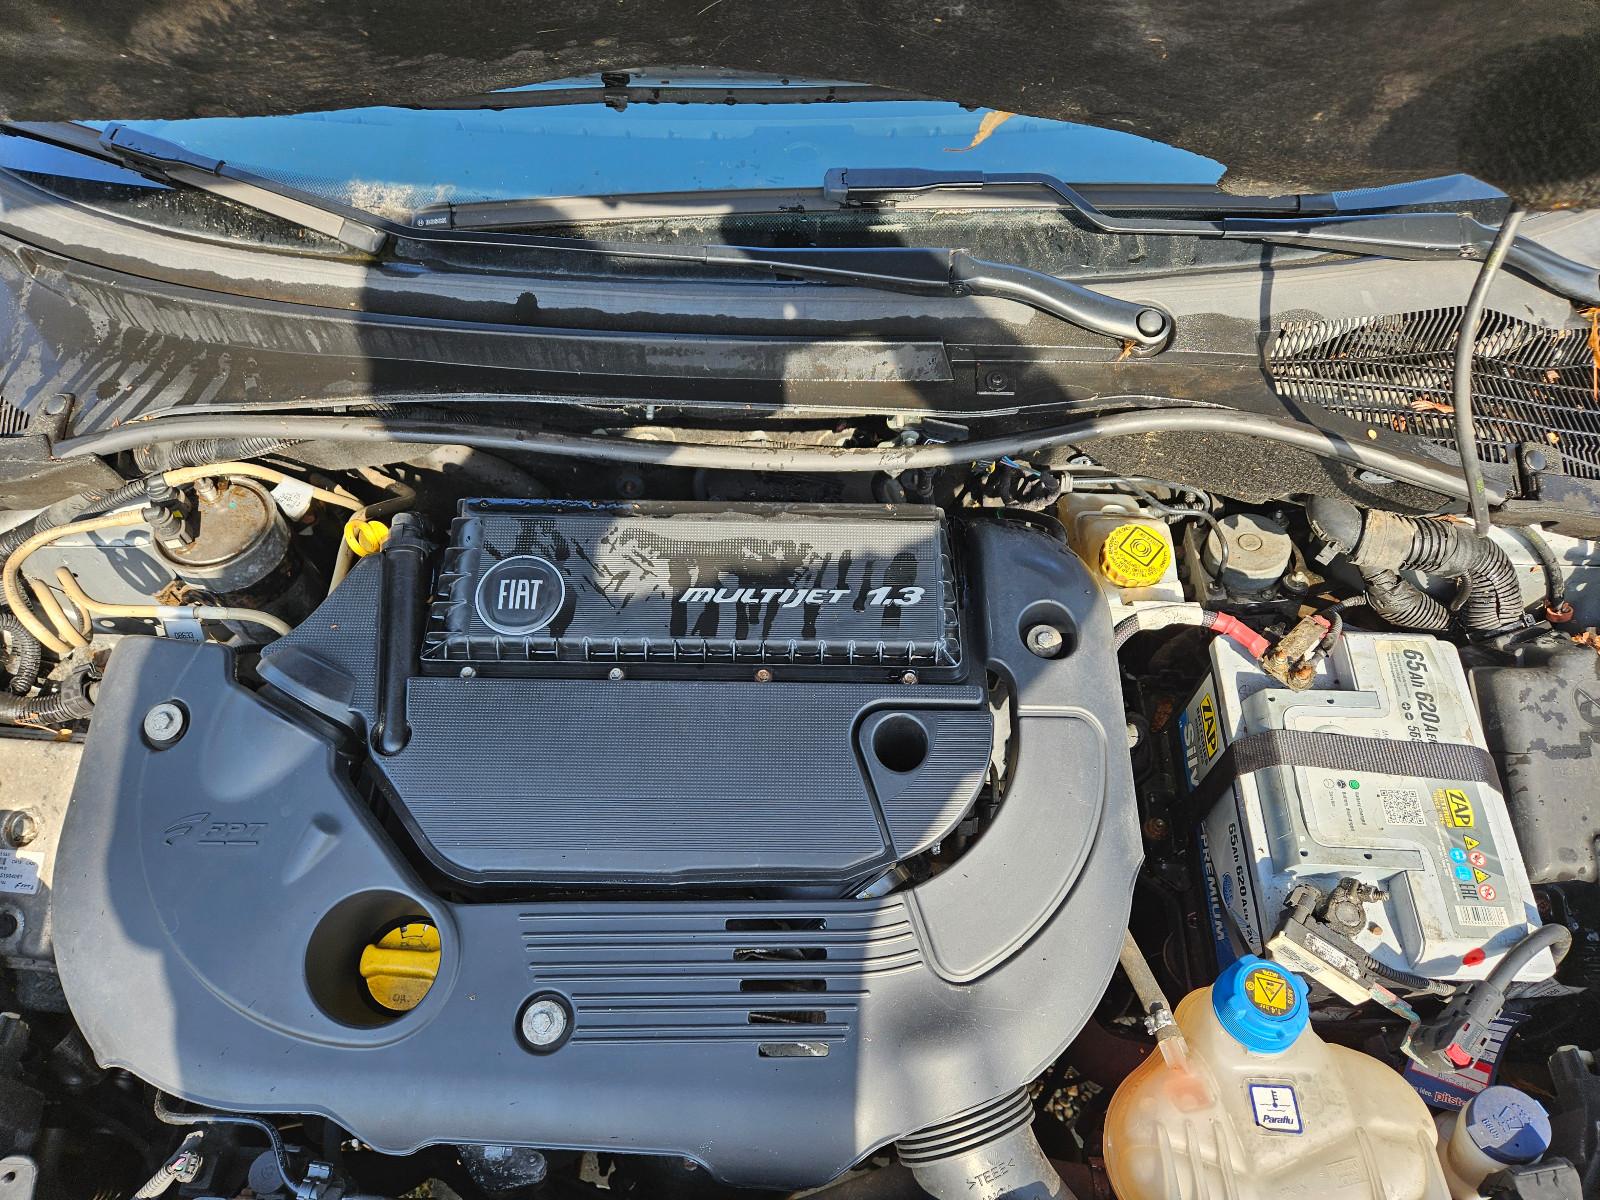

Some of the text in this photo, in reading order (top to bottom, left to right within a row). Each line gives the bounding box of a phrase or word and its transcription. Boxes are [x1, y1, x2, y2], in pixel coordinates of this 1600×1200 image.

[498, 579, 543, 610] FIAT
[678, 586, 926, 608] MULTIJET 1.3
[1403, 649, 1428, 688] 65Ah
[1202, 698, 1217, 752] ZAP
[1448, 791, 1471, 826] ZAP
[1228, 822, 1239, 863] 65Ah
[1235, 865, 1248, 898] 620
[1200, 833, 1226, 942] PREMIUM
[1262, 1114, 1295, 1125] Paraflu
